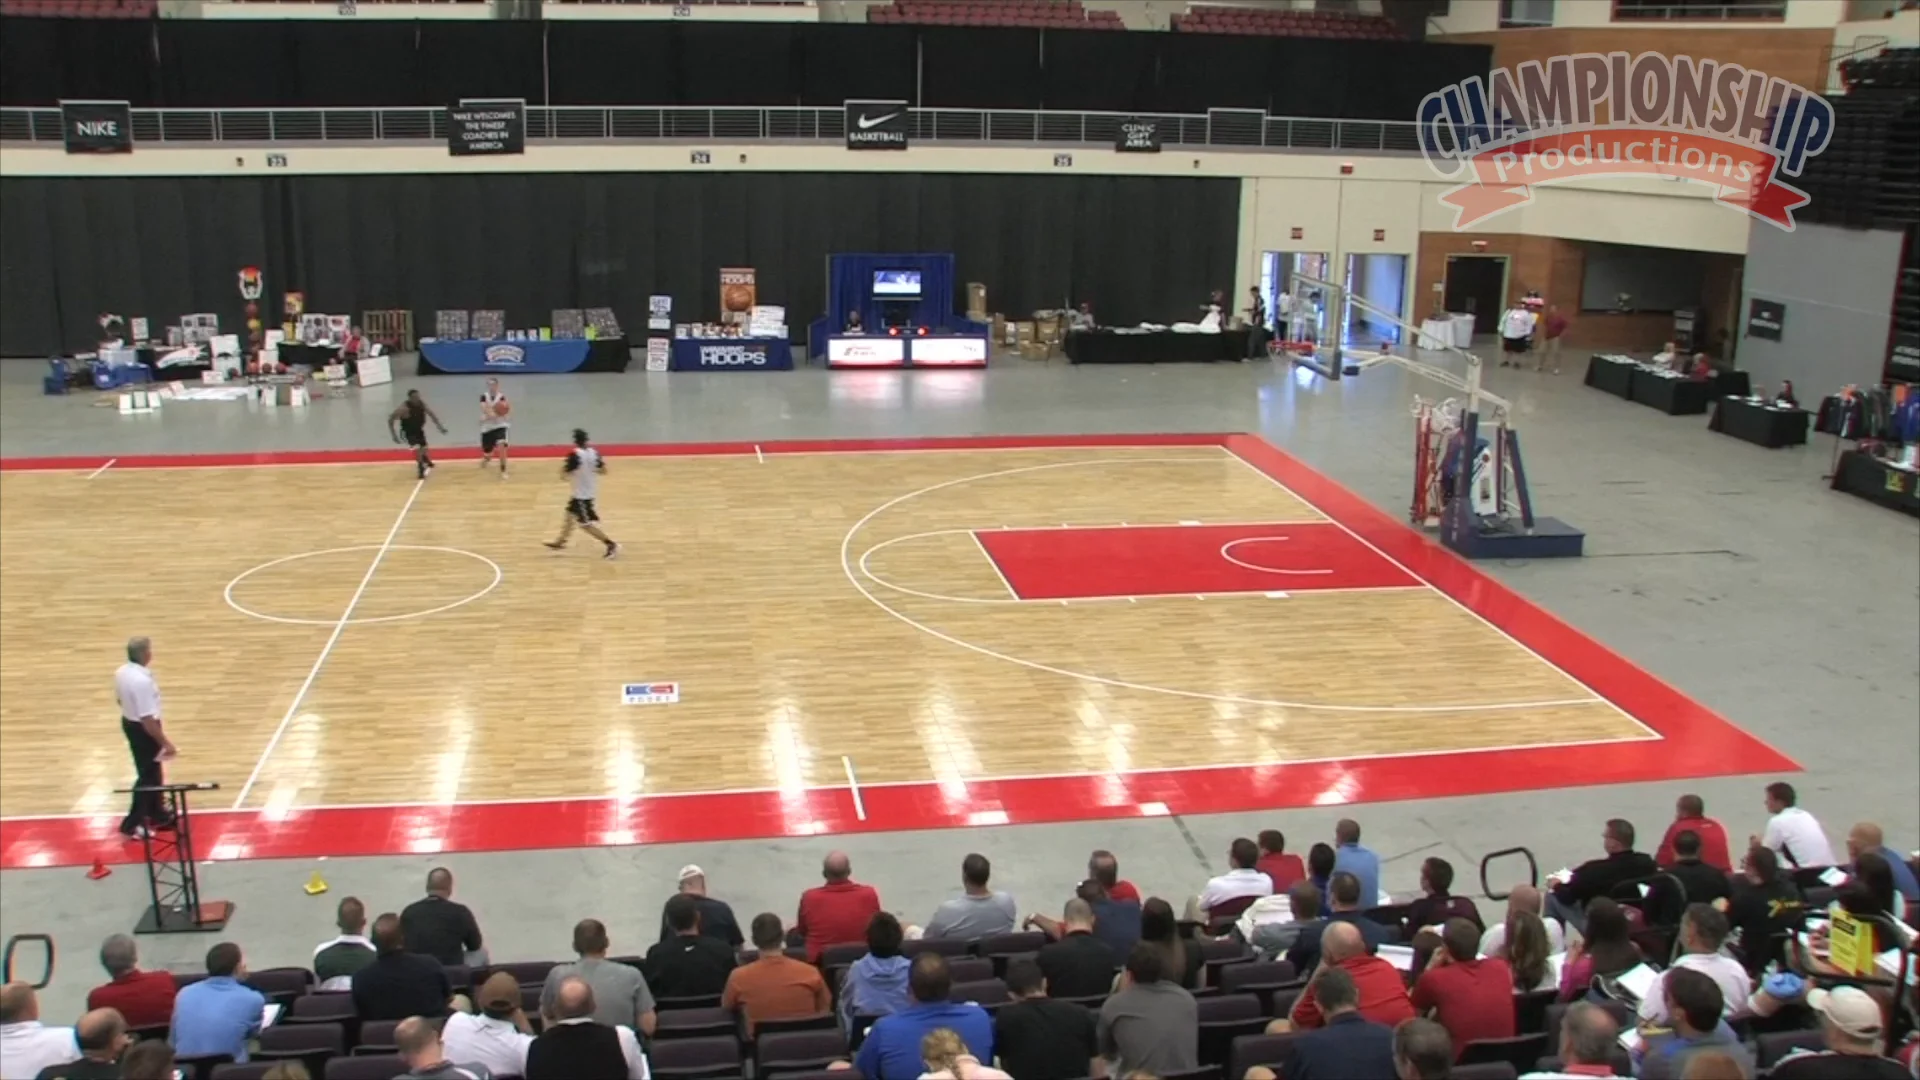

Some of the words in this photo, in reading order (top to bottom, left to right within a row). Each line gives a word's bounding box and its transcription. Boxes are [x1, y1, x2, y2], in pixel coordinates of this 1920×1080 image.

[76, 121, 117, 136] NIKE
[849, 131, 905, 142] BASKETBALL
[701, 351, 767, 365] HOOPS
